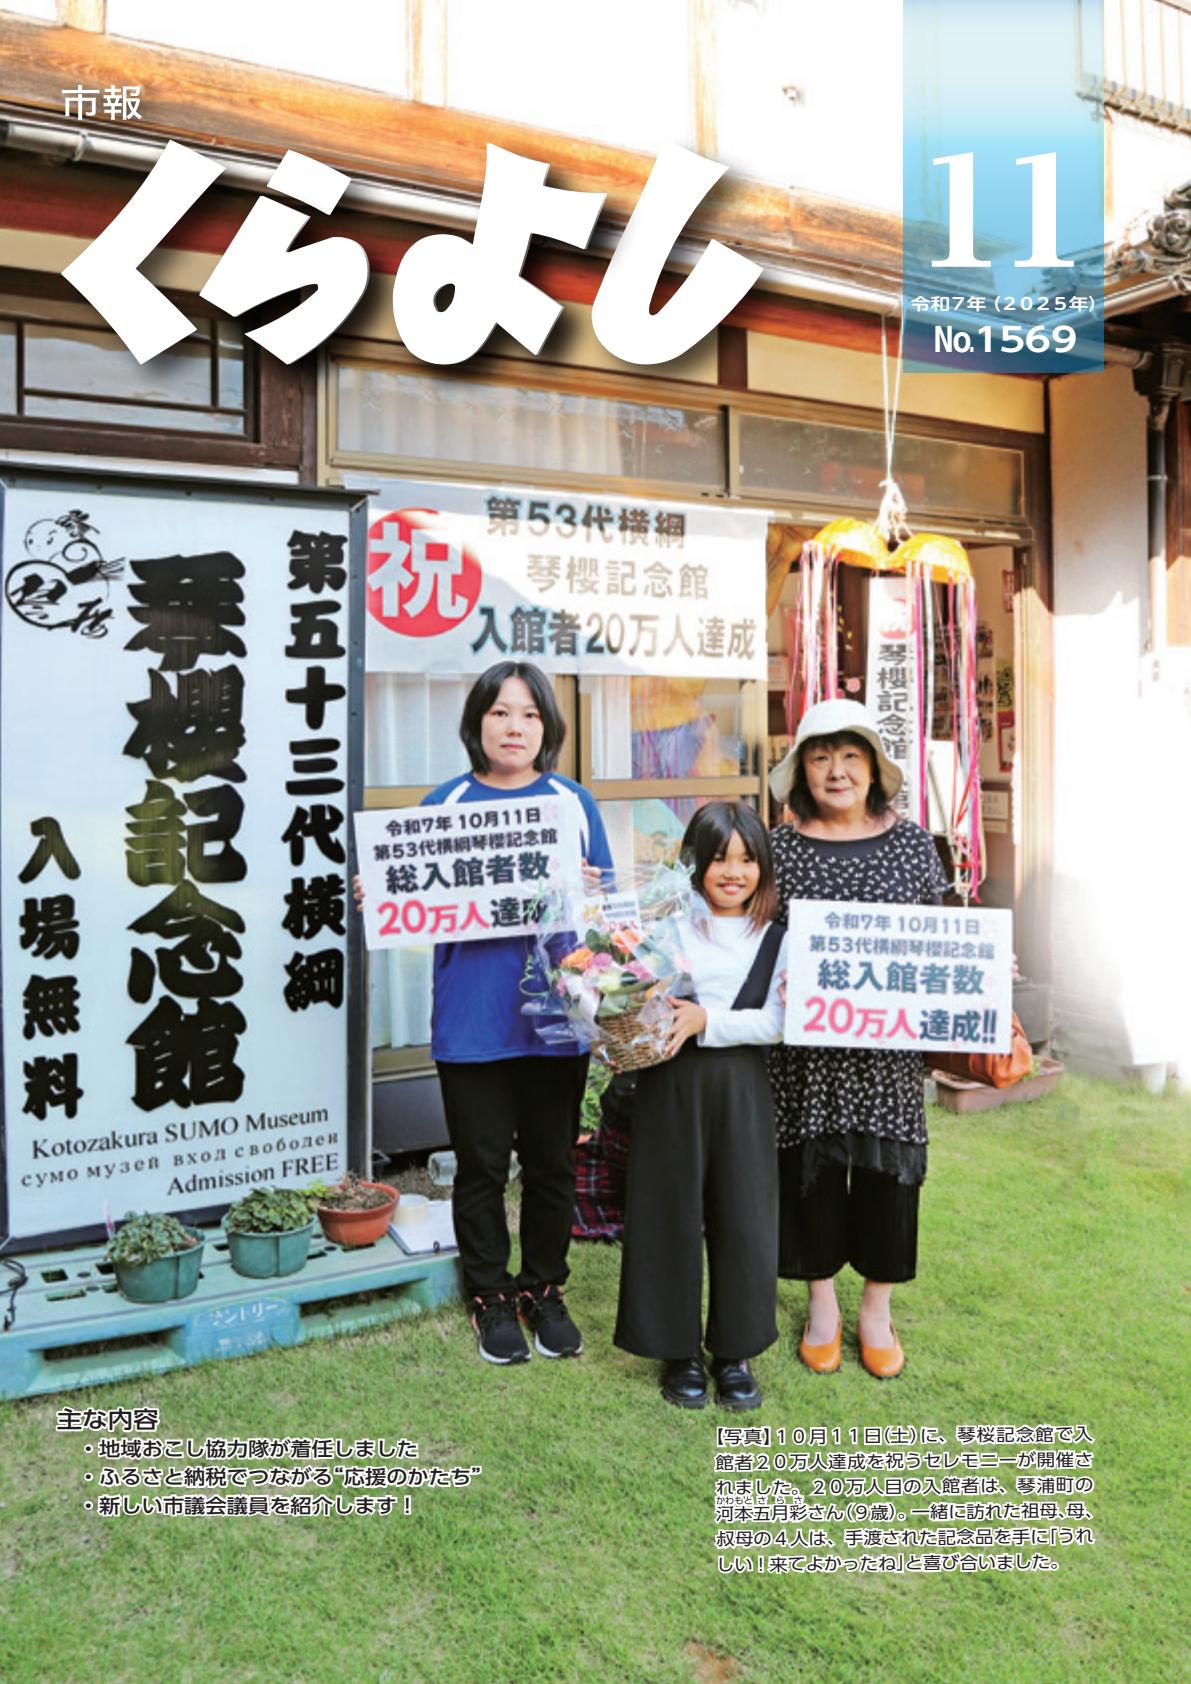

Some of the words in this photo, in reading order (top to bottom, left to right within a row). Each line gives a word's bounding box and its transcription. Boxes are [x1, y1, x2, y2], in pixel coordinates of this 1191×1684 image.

[486, 496, 686, 550] 第53代横綱
[367, 521, 468, 619] 祝
[526, 553, 709, 601] 琴櫻記念館
[471, 607, 757, 660] 入館者20万人達成
[281, 530, 348, 1012] 第五十三代横綱
[123, 551, 248, 1112] 琴櫻記念館
[386, 851, 550, 895] 総入館者数
[18, 816, 83, 1120] 入場無料
[817, 959, 985, 995] 総入館者数
[32, 1130, 158, 1160] Kotozakura
[164, 1117, 239, 1143] SUMO
[246, 1106, 328, 1133] Museum
[167, 1160, 275, 1196] Admission
[282, 1152, 339, 1178] FREE
